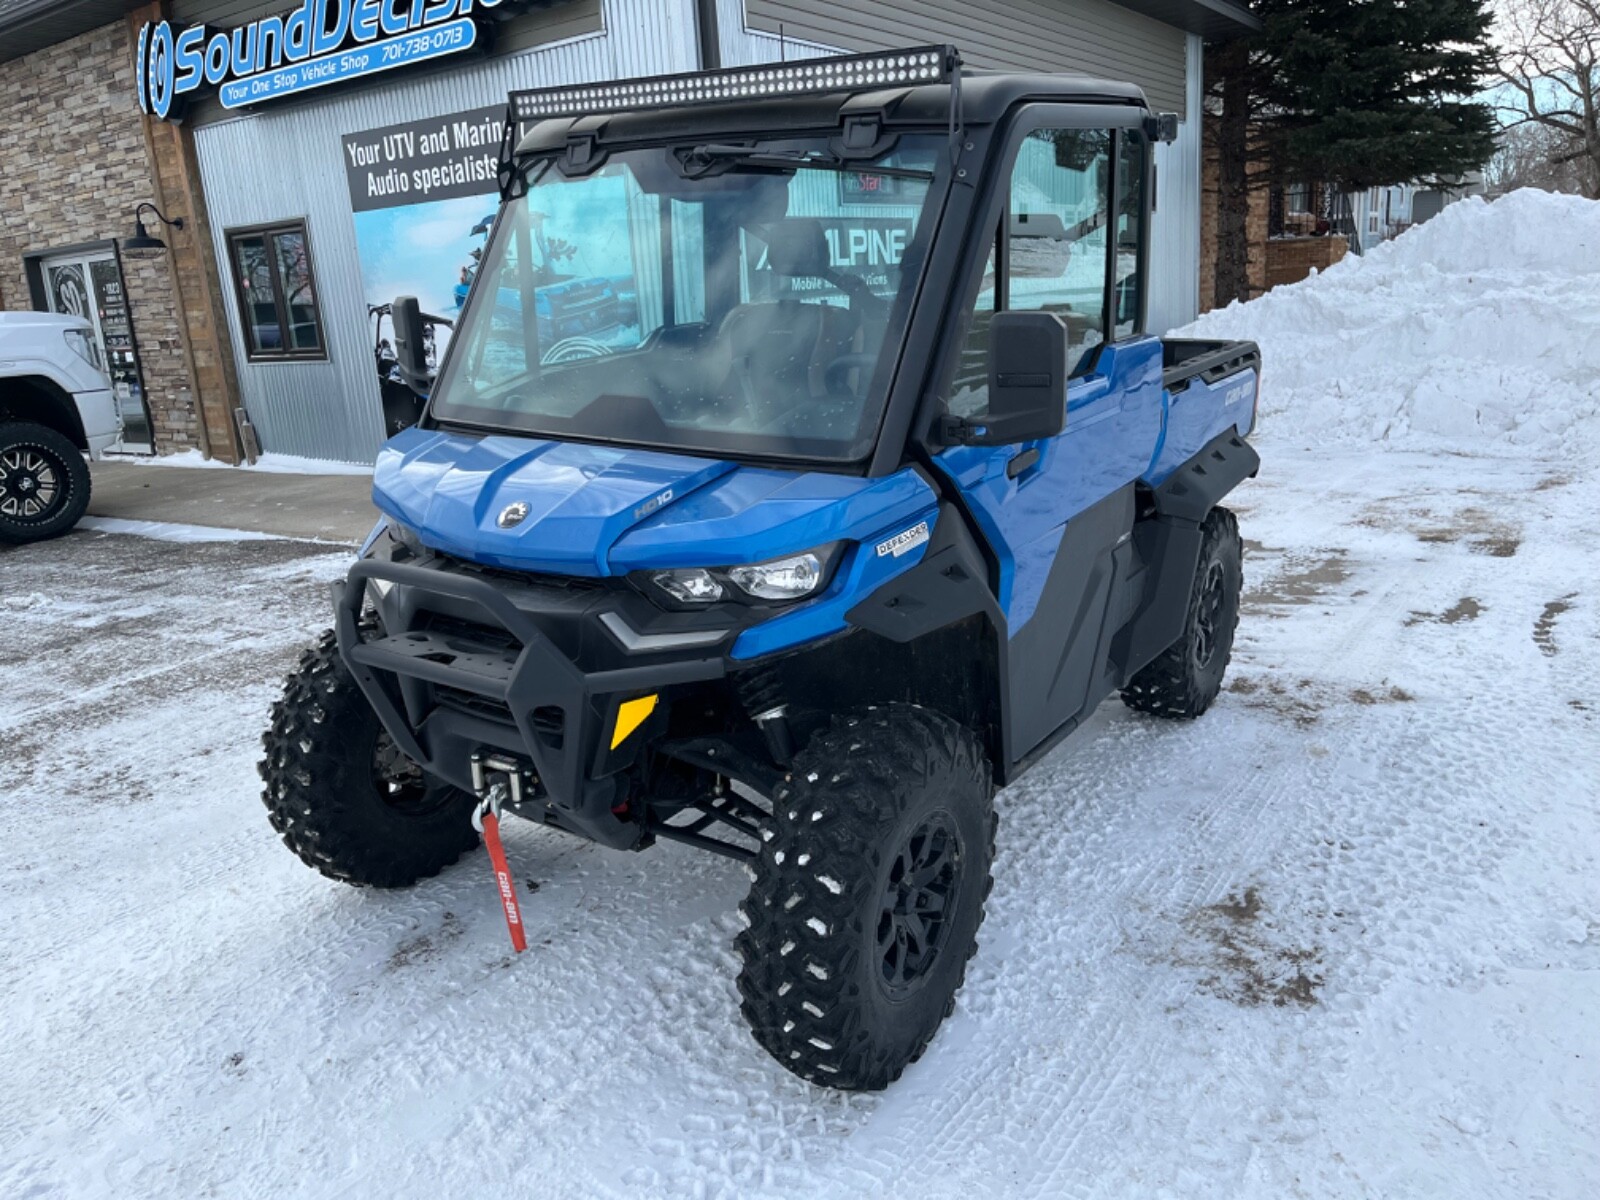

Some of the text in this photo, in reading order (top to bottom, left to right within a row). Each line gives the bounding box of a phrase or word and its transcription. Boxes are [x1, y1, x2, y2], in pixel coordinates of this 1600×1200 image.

[227, 26, 464, 101] Your One Stop Vehicle Shop 701-738-0713
[347, 141, 380, 167] Your
[383, 131, 415, 161] UTV
[420, 125, 450, 155] and
[367, 154, 499, 197] Audio specialists
[634, 489, 673, 519] HD10
[878, 522, 927, 555] DEFENDER
